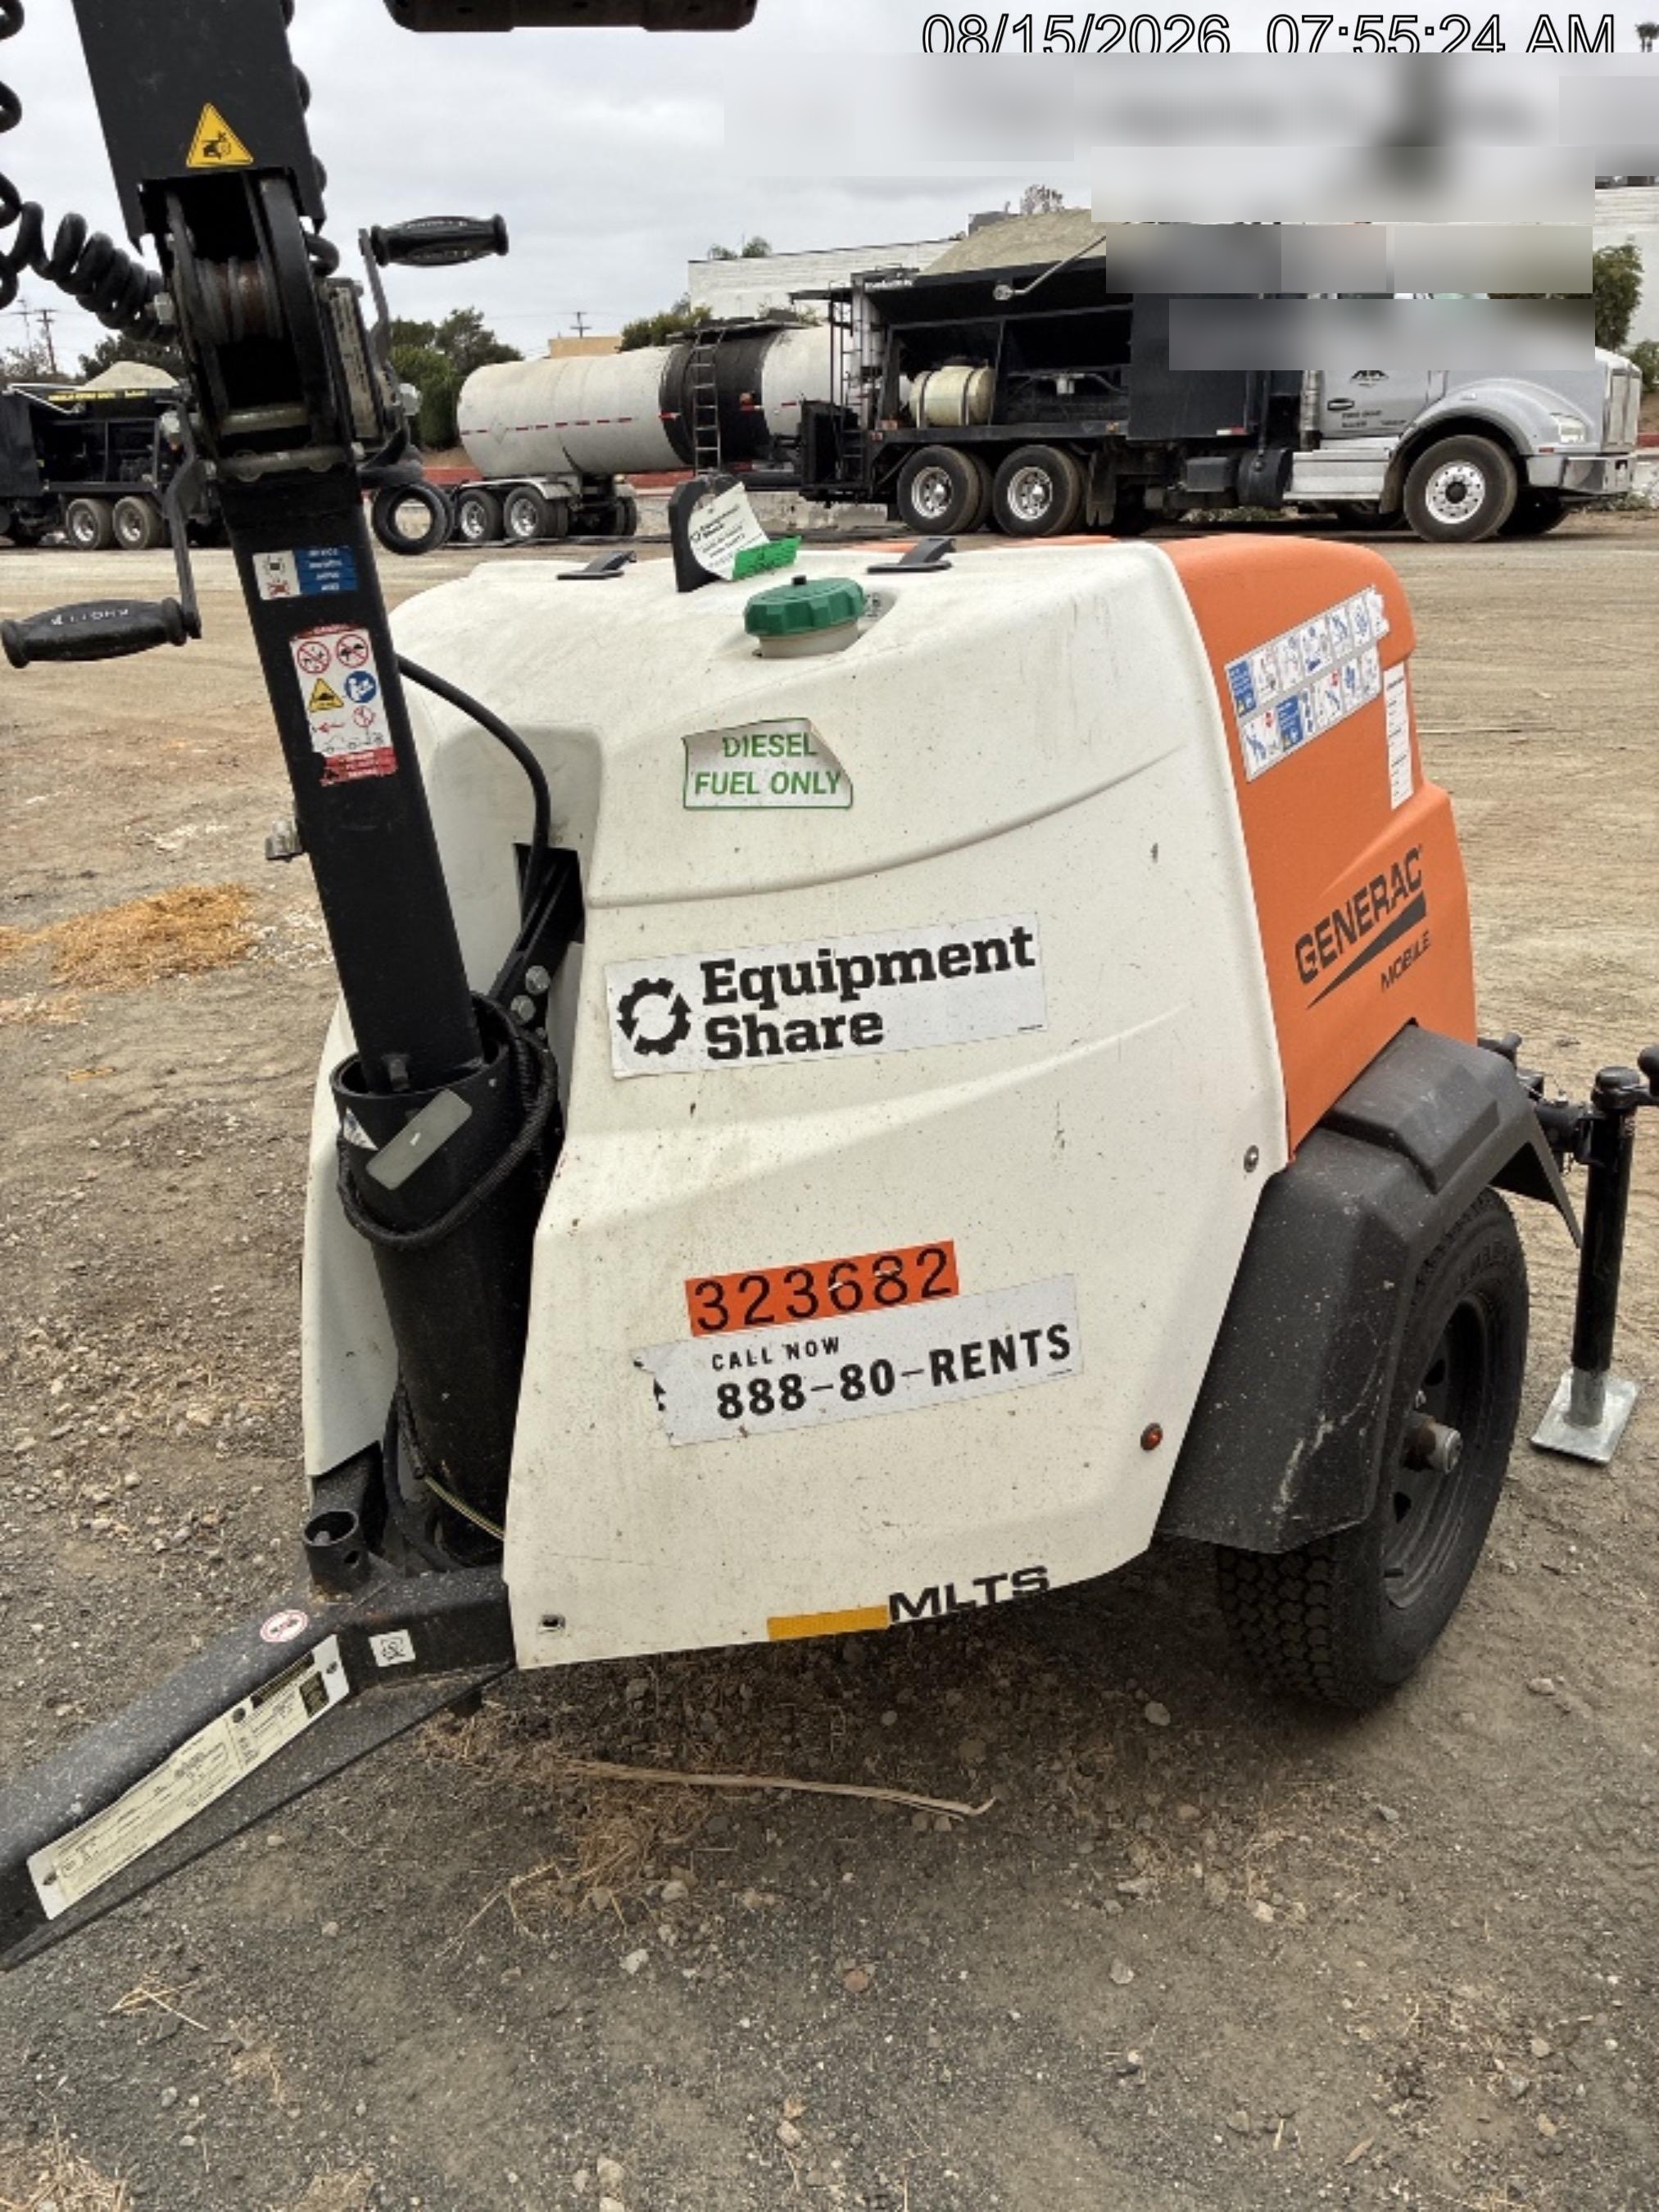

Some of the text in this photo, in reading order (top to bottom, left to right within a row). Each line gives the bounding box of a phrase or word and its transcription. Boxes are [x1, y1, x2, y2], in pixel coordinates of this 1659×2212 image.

[722, 732, 818, 758] DIESEL
[694, 771, 841, 795] FUEL ONLY
[1294, 847, 1422, 985] GENERAC
[700, 926, 1036, 1012] Equipment
[1381, 930, 1431, 993] MOBILE
[705, 1011, 883, 1060] Share
[694, 1248, 952, 1332] 323682
[712, 1336, 841, 1371] CALL NOW
[716, 1323, 1071, 1421] 888-80-RENTS
[889, 1565, 1050, 1623] MLTS
